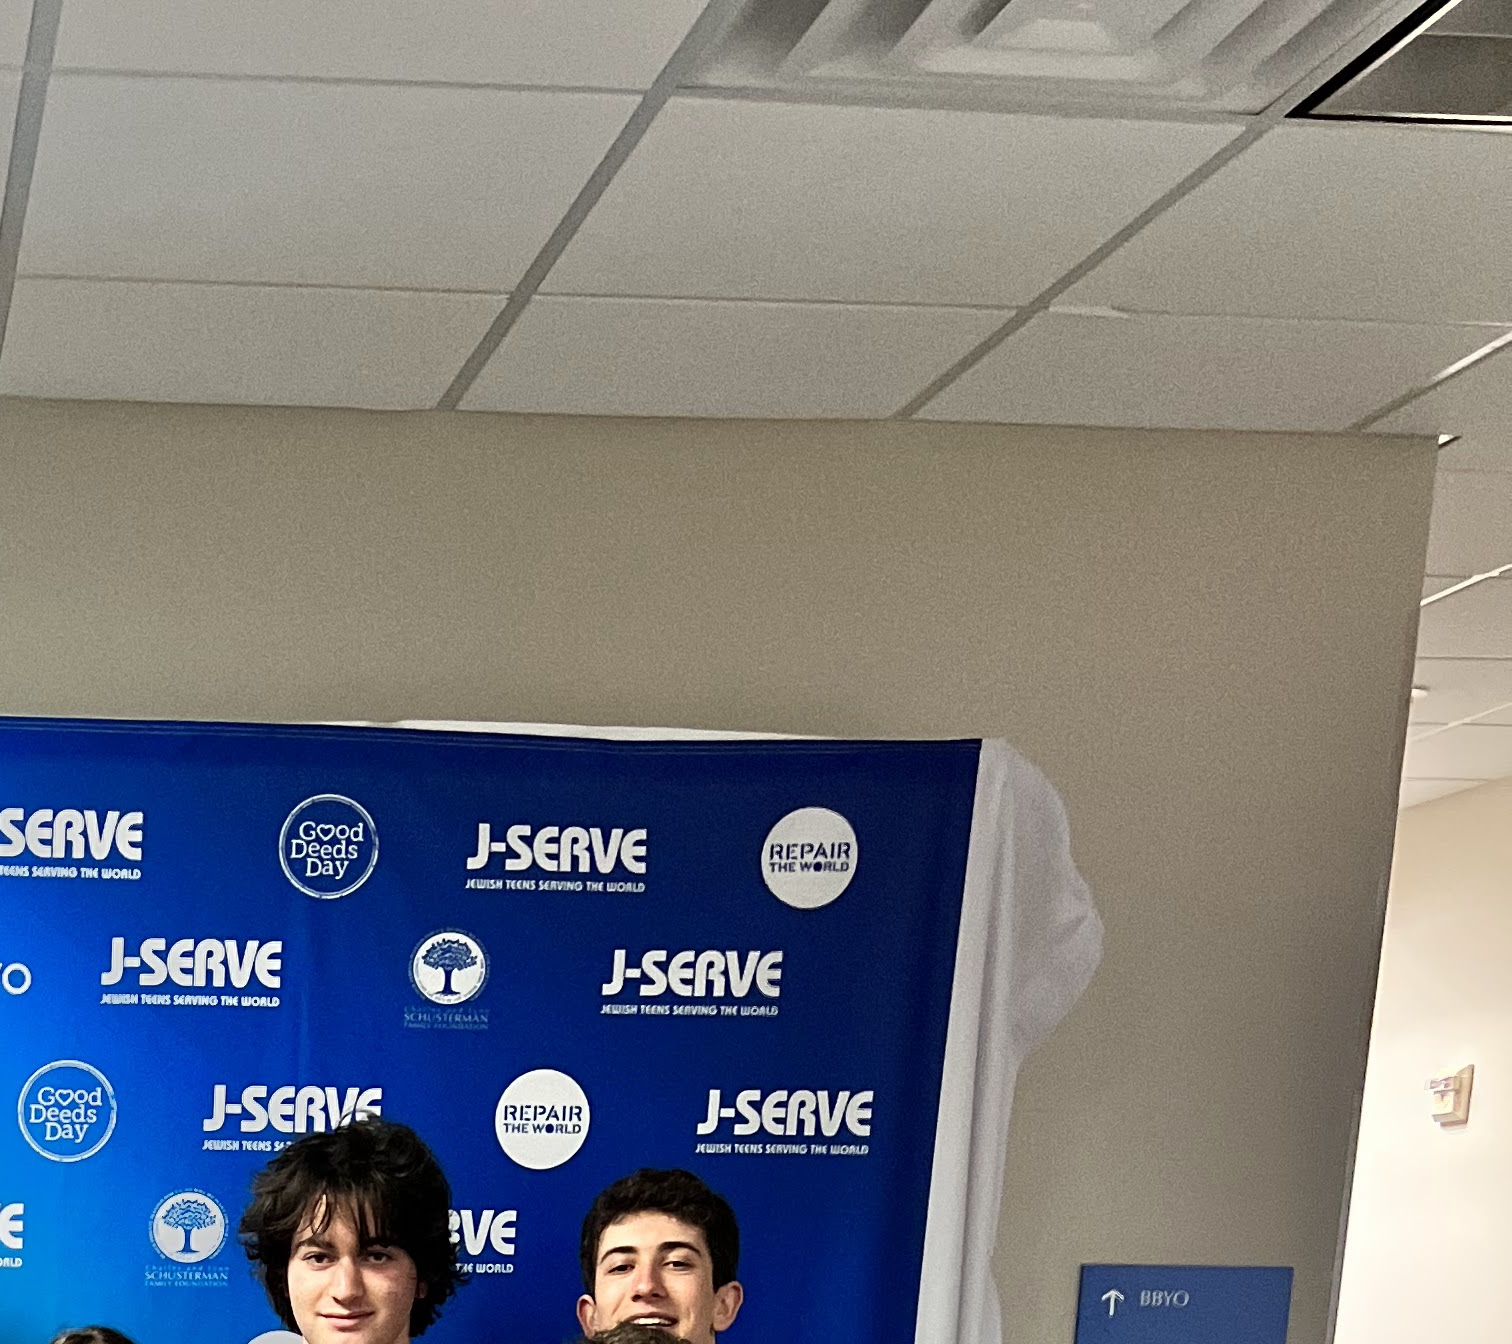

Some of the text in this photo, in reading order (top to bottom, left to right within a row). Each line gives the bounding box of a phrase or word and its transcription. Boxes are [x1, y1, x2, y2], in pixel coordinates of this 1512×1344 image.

[290, 839, 358, 859] Deeds
[467, 823, 647, 873] J-SERVE
[769, 841, 851, 861] REPAIR
[32, 865, 78, 878] SERVING
[80, 867, 98, 879] THE
[101, 867, 141, 880] WORLD
[305, 857, 349, 880] Day
[769, 861, 850, 873] THE WORLD
[465, 878, 645, 893] JEWISH TEENS SERVING THE WORLD
[101, 937, 283, 988] J-SERVE
[602, 950, 783, 997] J-SERVE
[100, 993, 280, 1008] JEWISH TEENS SERVING THE WORLD
[600, 1003, 778, 1017] JEWISH TEENS SERVING THE WORLD
[29, 1103, 97, 1124] Deeds
[203, 1085, 382, 1133] J-SERVE
[503, 1104, 583, 1122] REPAIR
[697, 1090, 874, 1137] J-SERVE
[44, 1121, 89, 1144] Day
[502, 1123, 582, 1135] THE WORLD
[695, 1143, 868, 1155] JEWISH TEENS SERVING THE WORLD
[1139, 1290, 1190, 1308] BBYO
